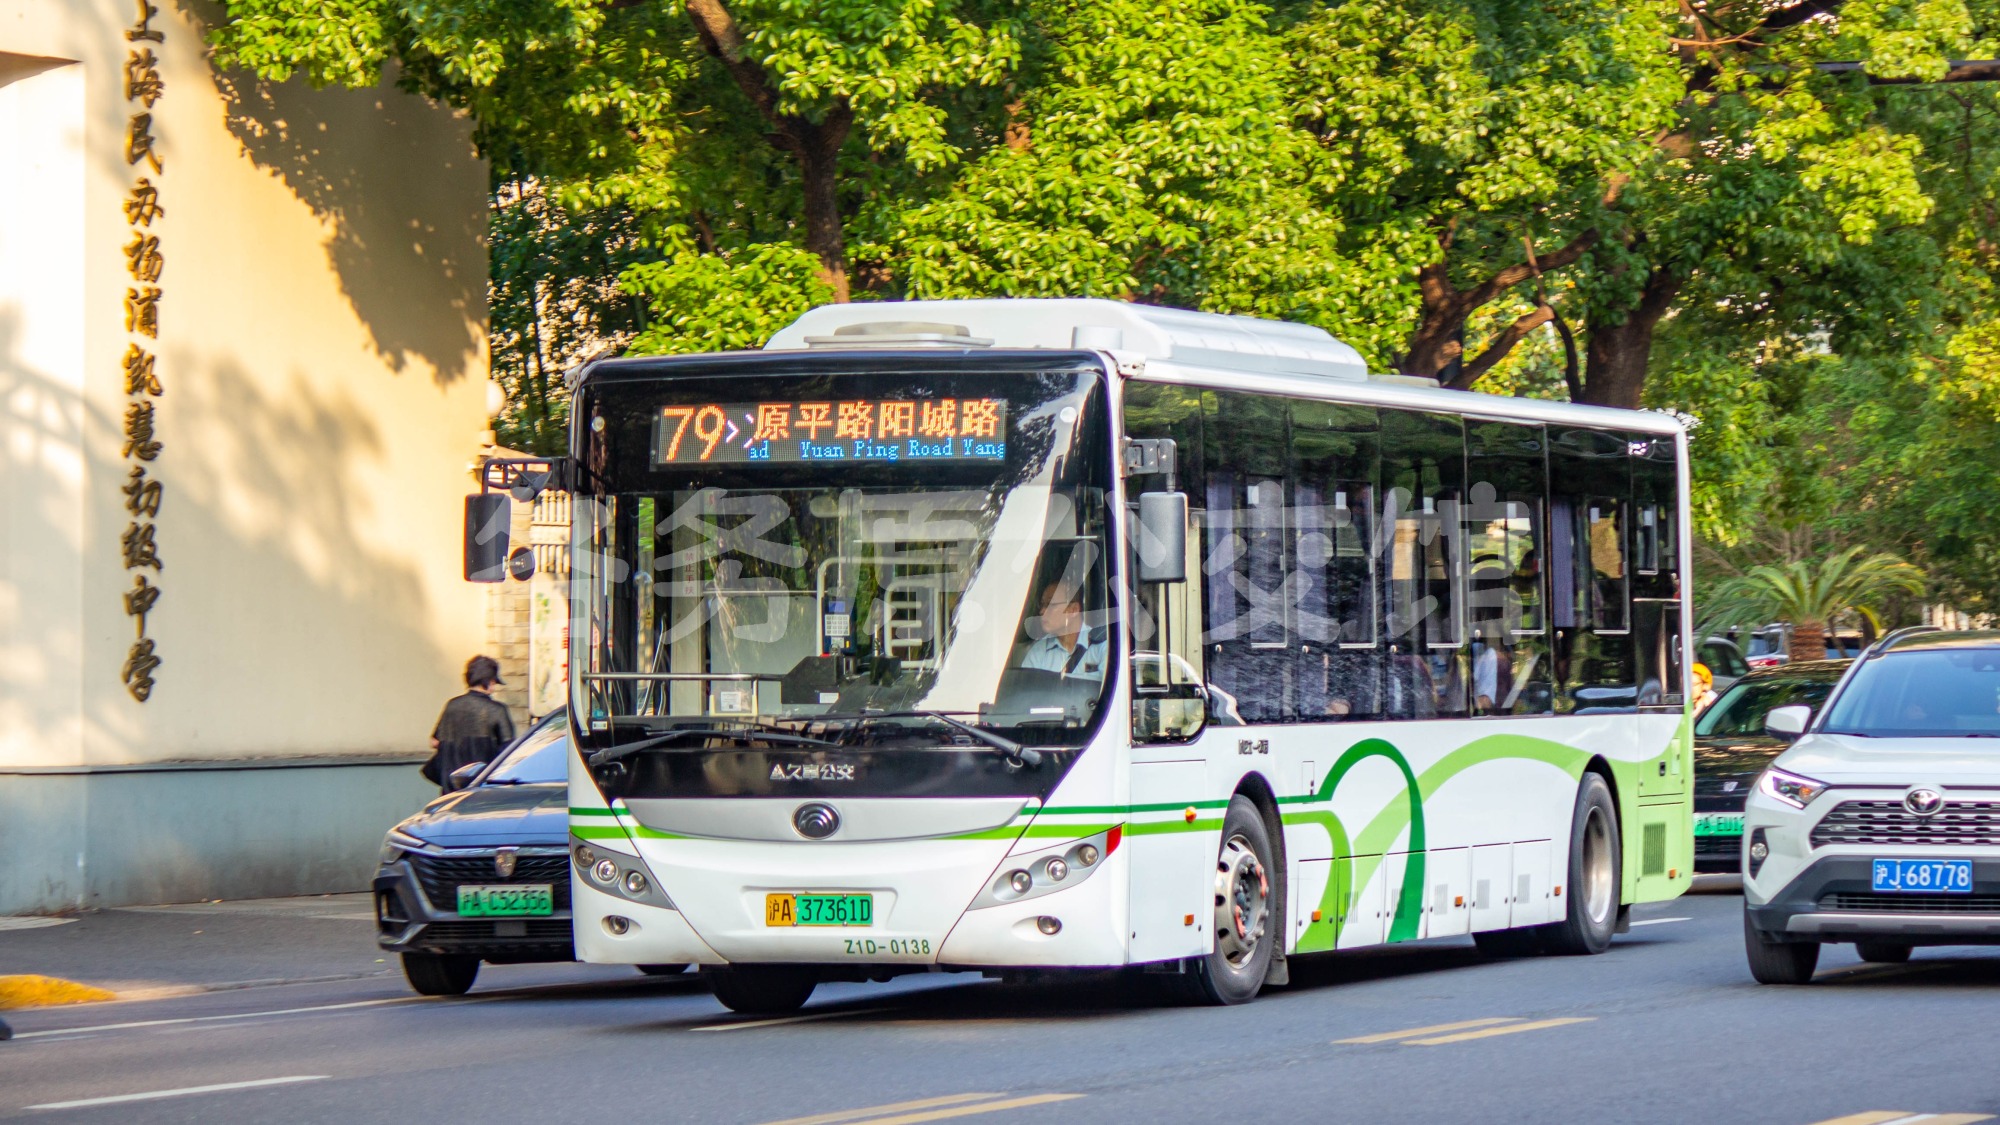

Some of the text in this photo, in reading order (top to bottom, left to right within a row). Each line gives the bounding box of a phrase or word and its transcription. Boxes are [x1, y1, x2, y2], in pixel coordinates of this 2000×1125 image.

[663, 405, 726, 461] 79
[753, 399, 1000, 440] 原平路阳城路
[800, 440, 845, 458] Yuan
[854, 439, 899, 460] Ping
[908, 438, 953, 457] Road
[844, 939, 931, 955] Z1D-0138
